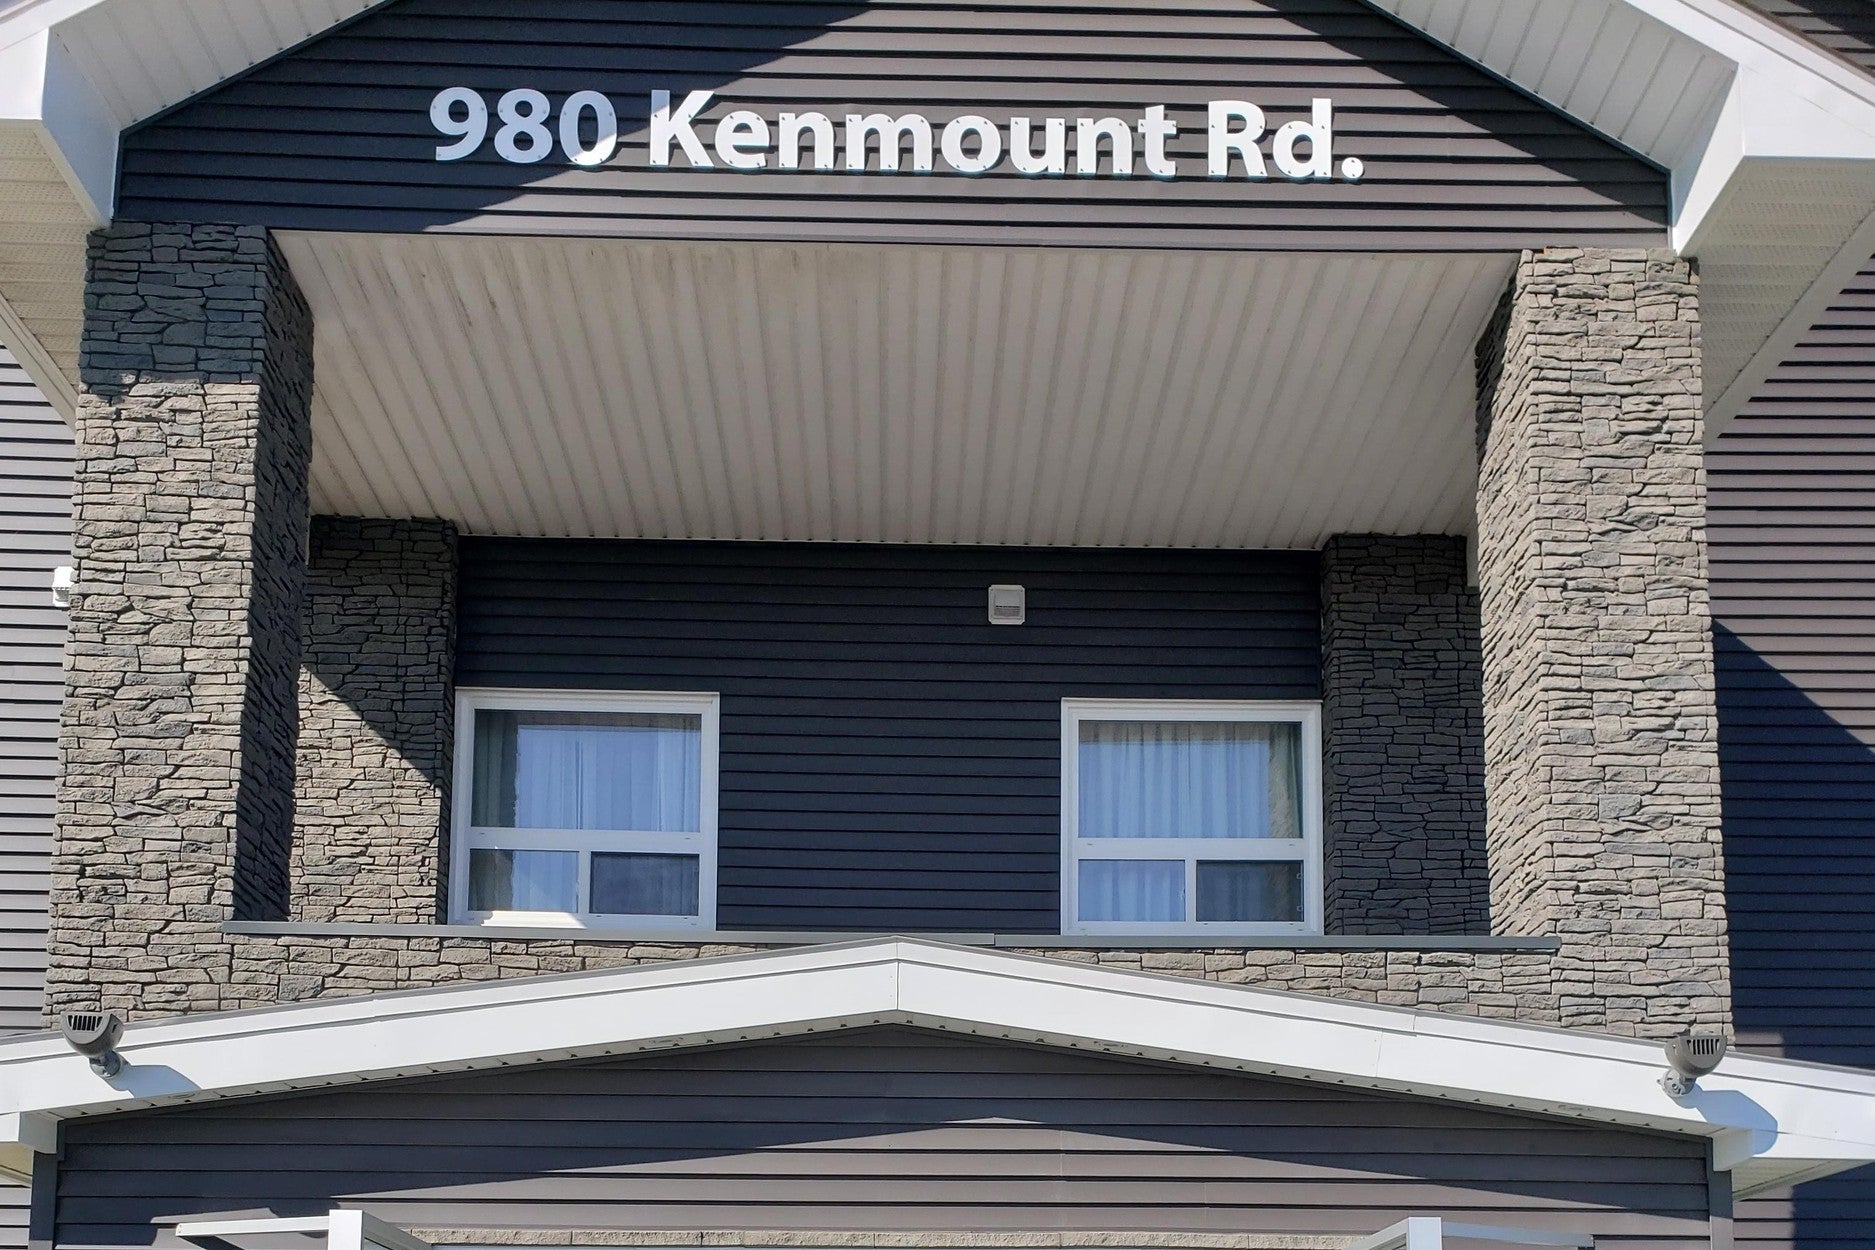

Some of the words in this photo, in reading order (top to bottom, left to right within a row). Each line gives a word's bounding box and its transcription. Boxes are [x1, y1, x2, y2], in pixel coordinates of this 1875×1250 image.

[429, 86, 618, 166] 980
[646, 89, 1178, 177] Kenmount
[1207, 98, 1366, 182] Rd.
